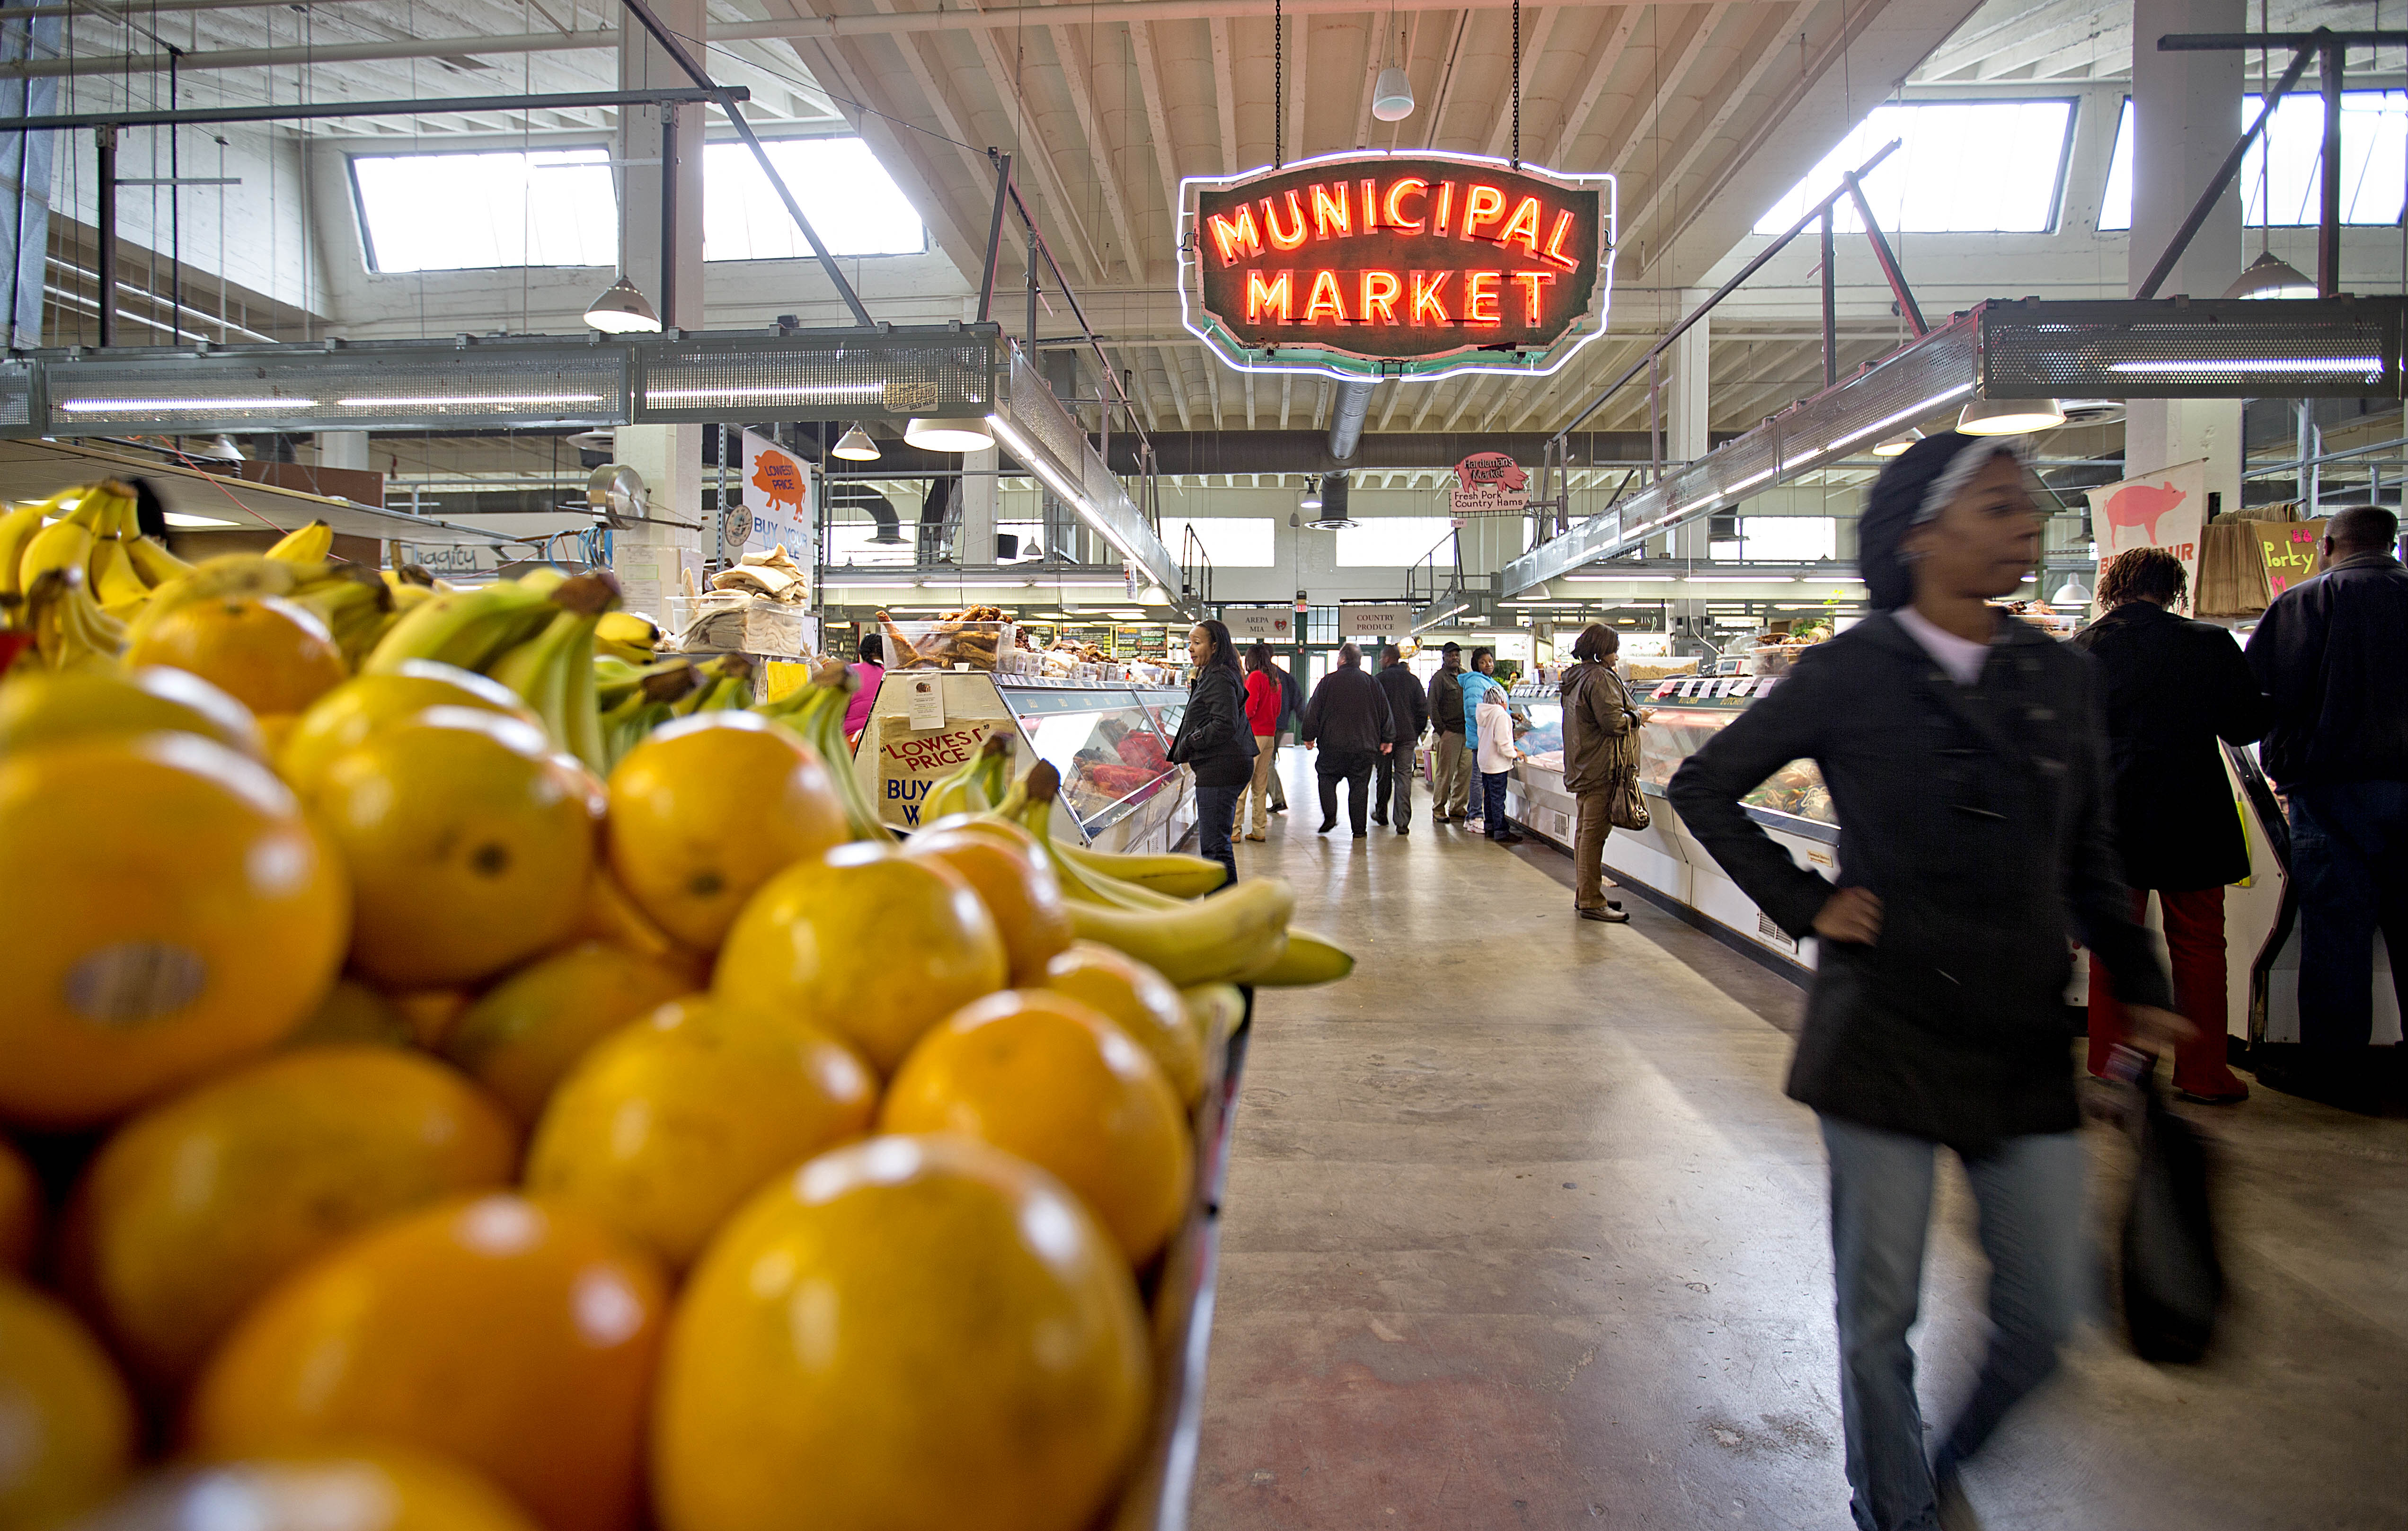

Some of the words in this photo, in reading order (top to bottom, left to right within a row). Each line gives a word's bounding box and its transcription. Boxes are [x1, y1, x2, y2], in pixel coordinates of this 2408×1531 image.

[1207, 178, 1579, 274] MUNICIPAL
[1246, 268, 1556, 328] MARKET
[888, 393, 913, 409] PHONE
[916, 387, 935, 401] CARD
[764, 465, 794, 476] LOWEST
[1472, 467, 1504, 481] Market
[772, 480, 795, 490] PRICE
[1454, 491, 1478, 500] Fresh
[1482, 490, 1502, 499] Pork
[1455, 500, 1493, 509] Country
[754, 517, 778, 537] BUY
[784, 526, 807, 549] YOUR
[2263, 540, 2314, 574] Porky
[905, 748, 970, 772] PRICE
[887, 779, 933, 800] BUY
